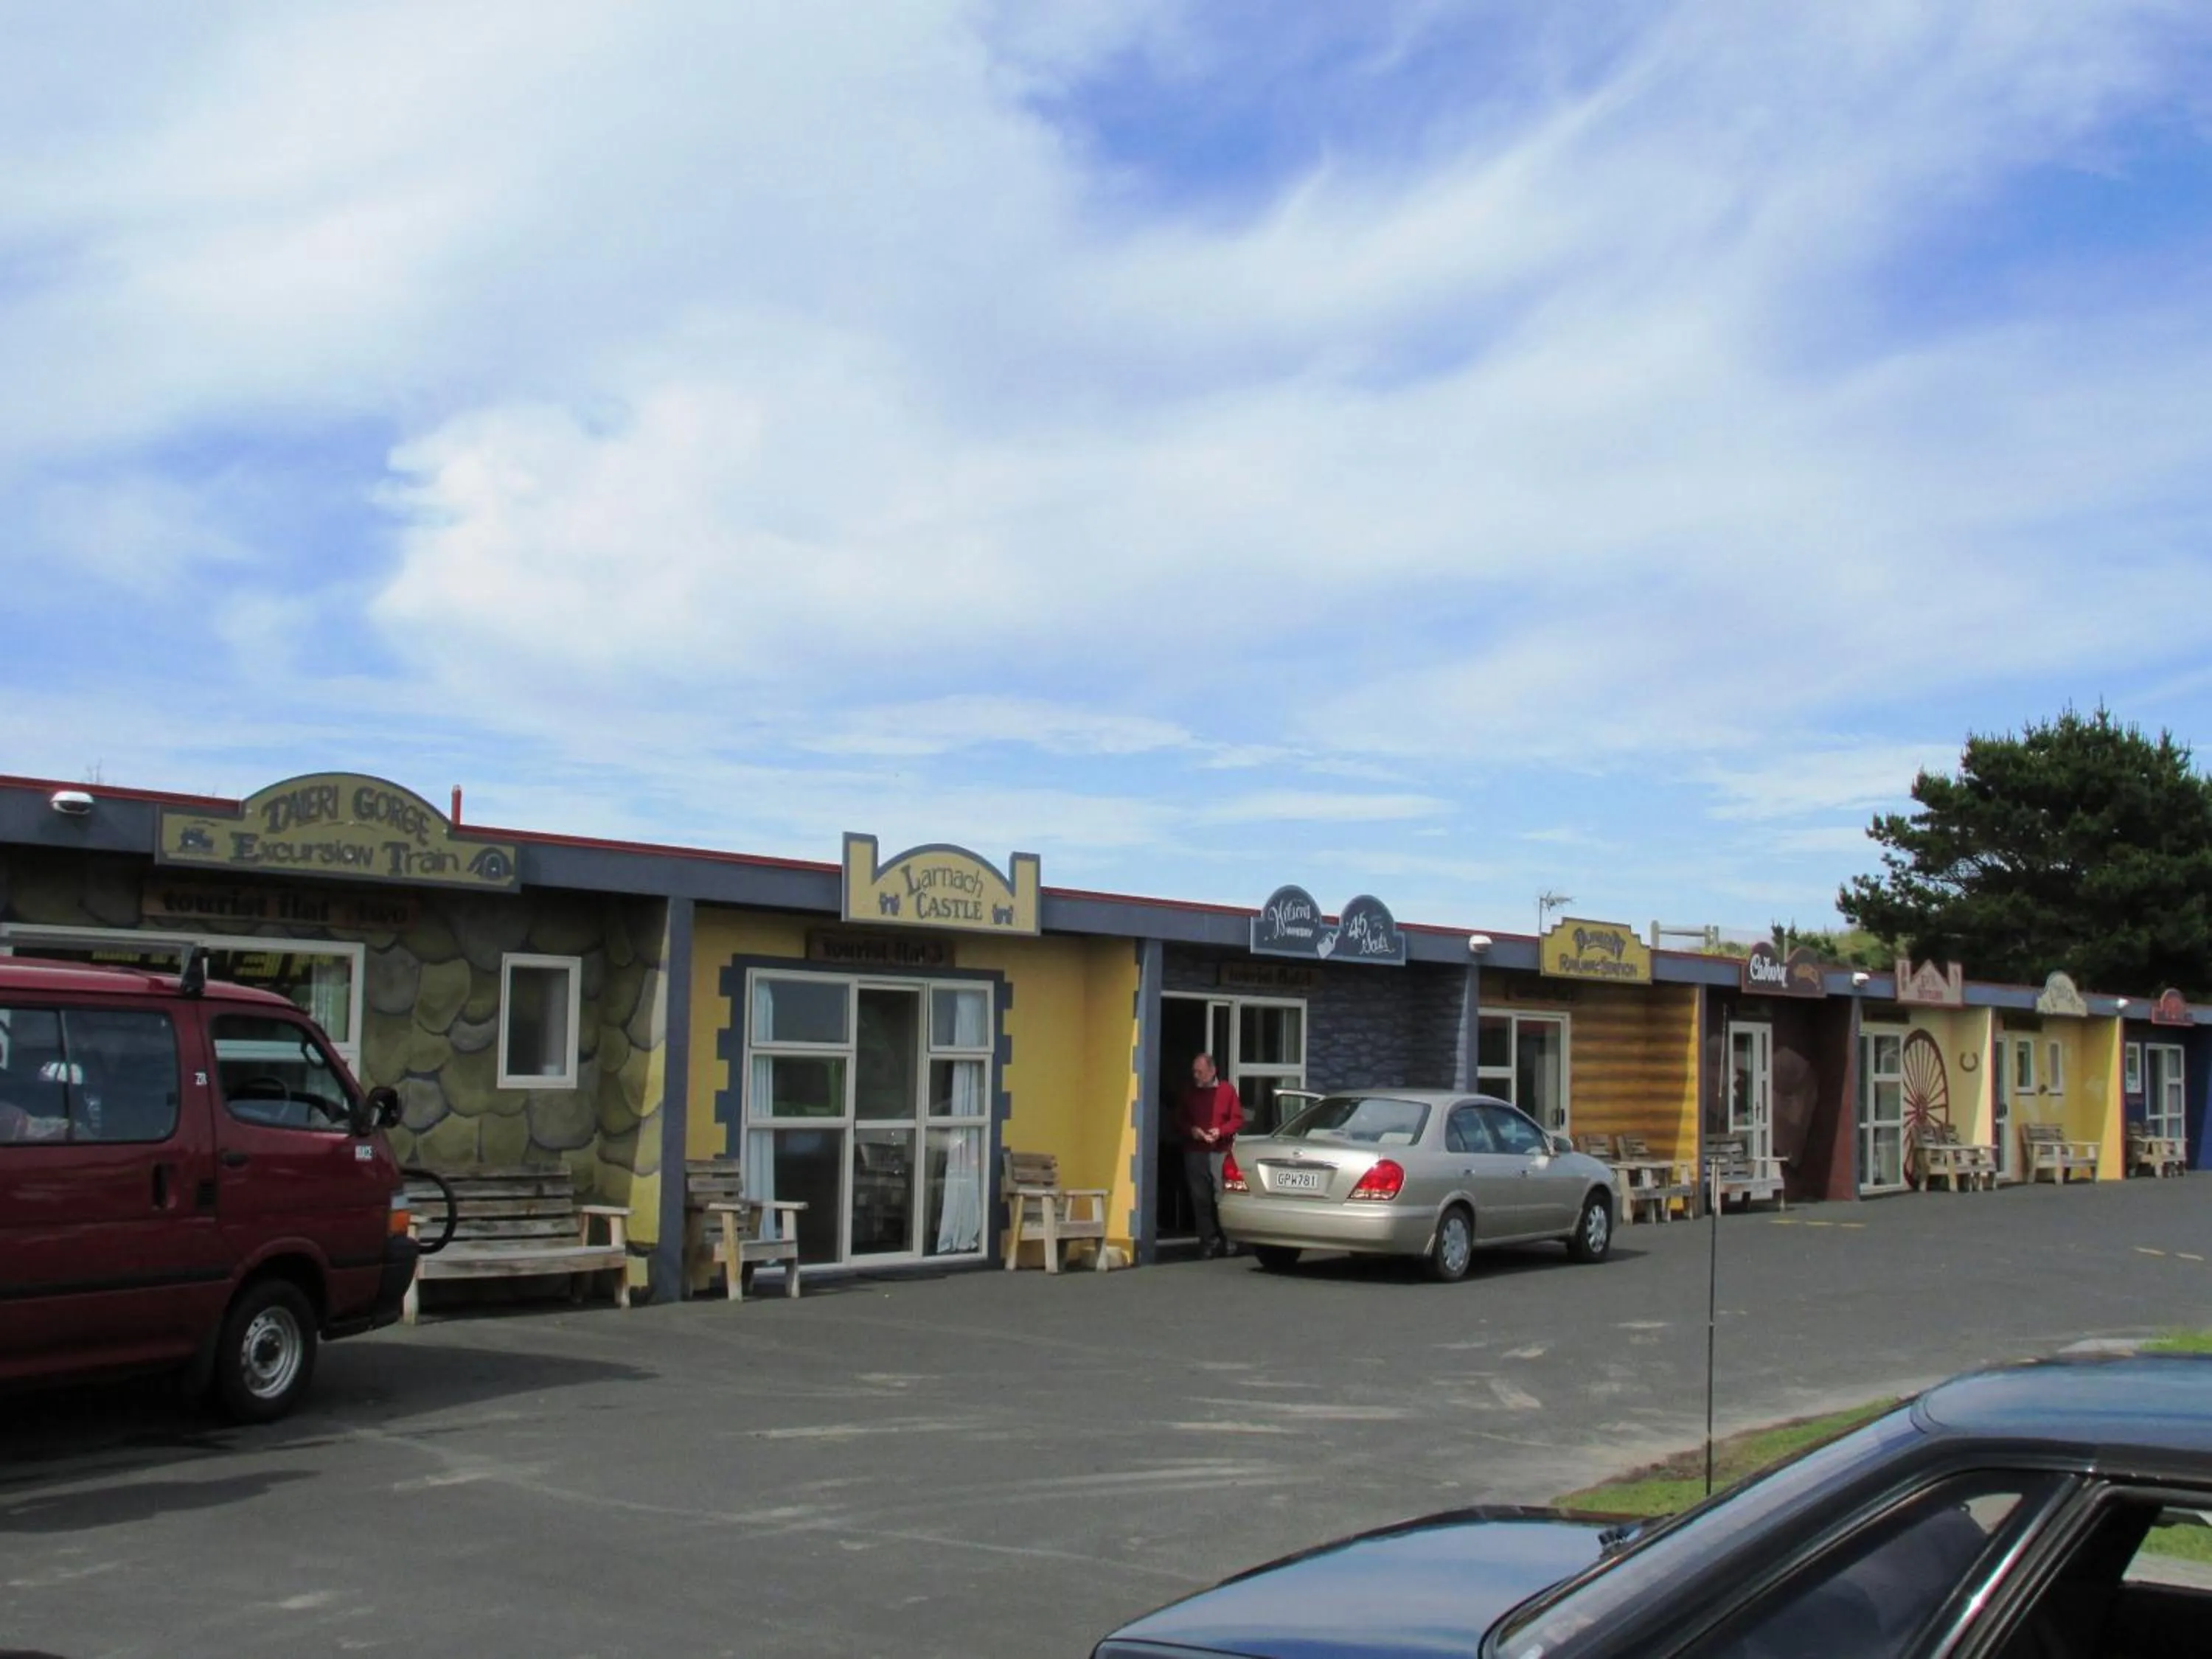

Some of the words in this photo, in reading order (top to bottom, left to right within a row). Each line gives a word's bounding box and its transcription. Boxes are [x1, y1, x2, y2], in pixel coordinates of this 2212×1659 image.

[352, 785, 432, 846] GORGE
[380, 841, 459, 877] Train
[900, 864, 984, 898] Larnach
[916, 892, 983, 921] CASTLE
[1278, 1172, 1315, 1188] GPW781
